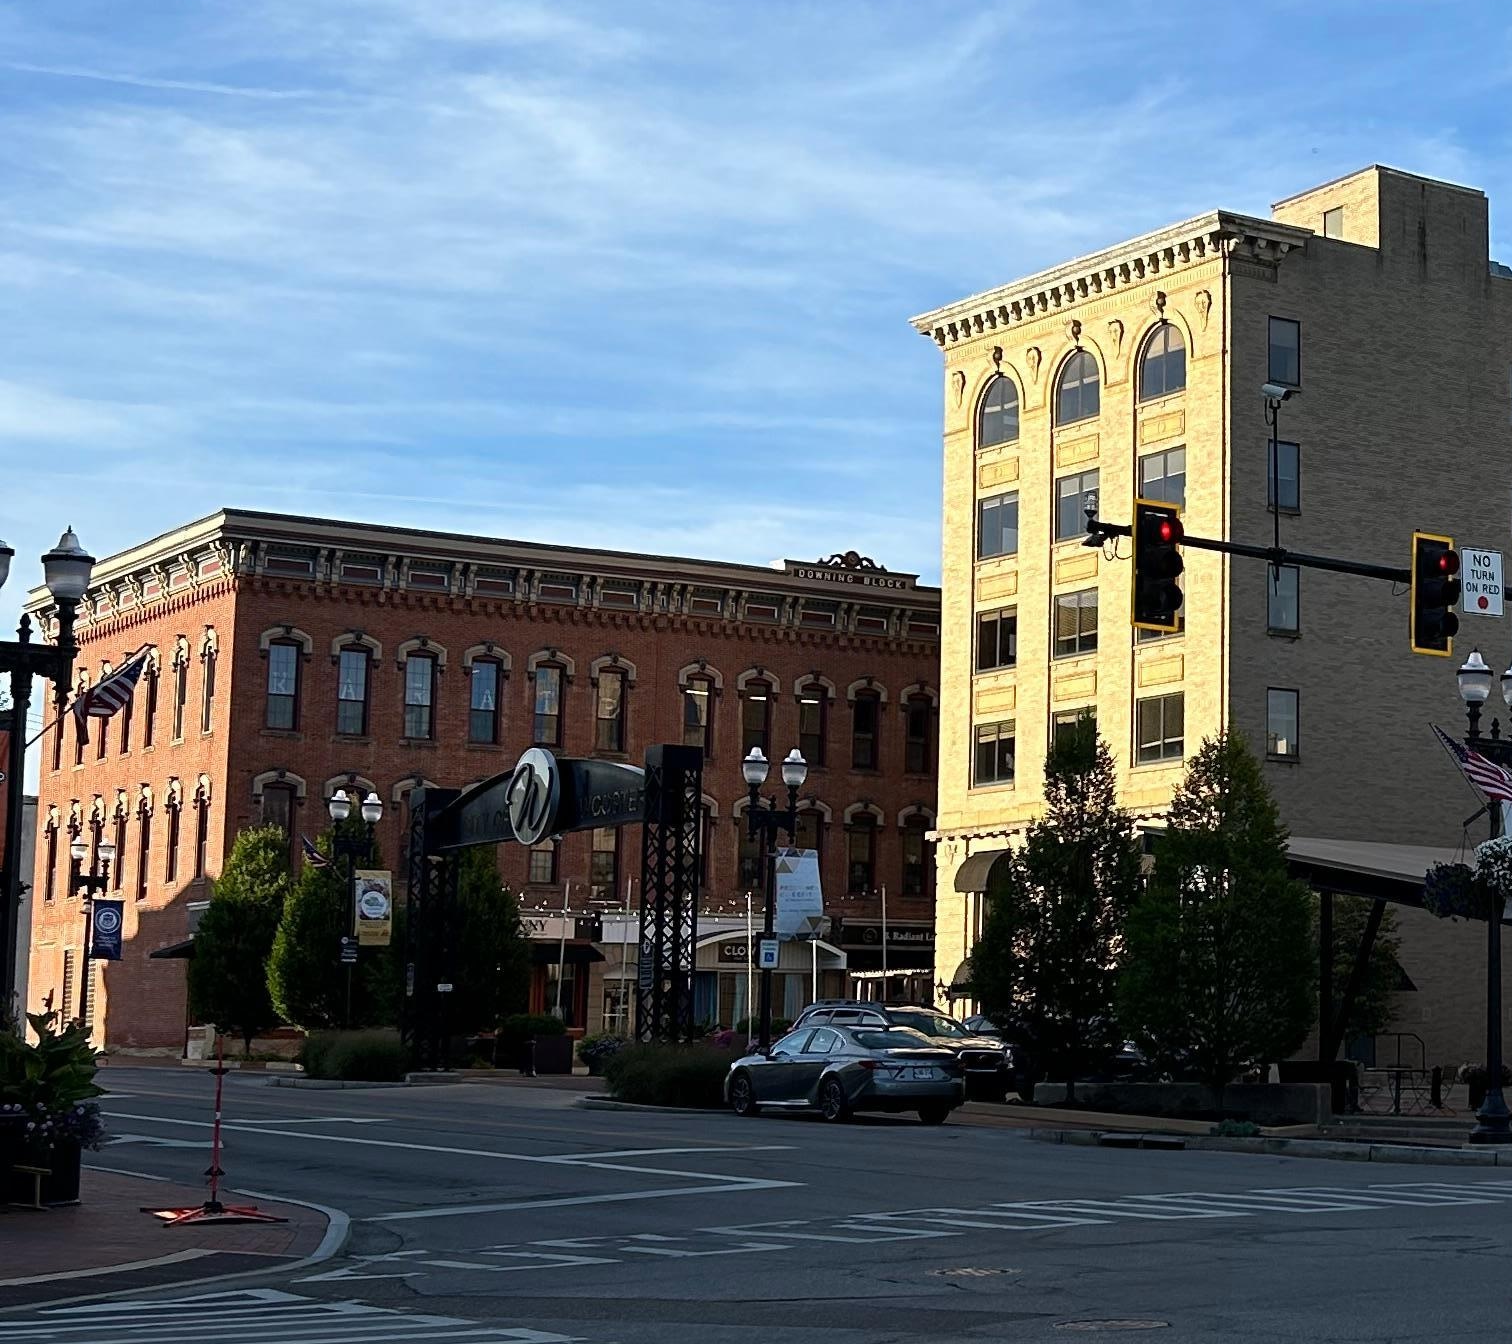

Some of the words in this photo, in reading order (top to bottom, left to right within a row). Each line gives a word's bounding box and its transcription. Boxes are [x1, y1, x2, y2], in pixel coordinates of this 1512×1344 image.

[1473, 553, 1491, 567] NO
[798, 568, 854, 583] DOWNING
[863, 576, 902, 589] BLOCK
[1470, 568, 1495, 582] TURN
[1465, 581, 1478, 593] ON
[1482, 583, 1500, 595] RED
[892, 930, 924, 941] Radiant
